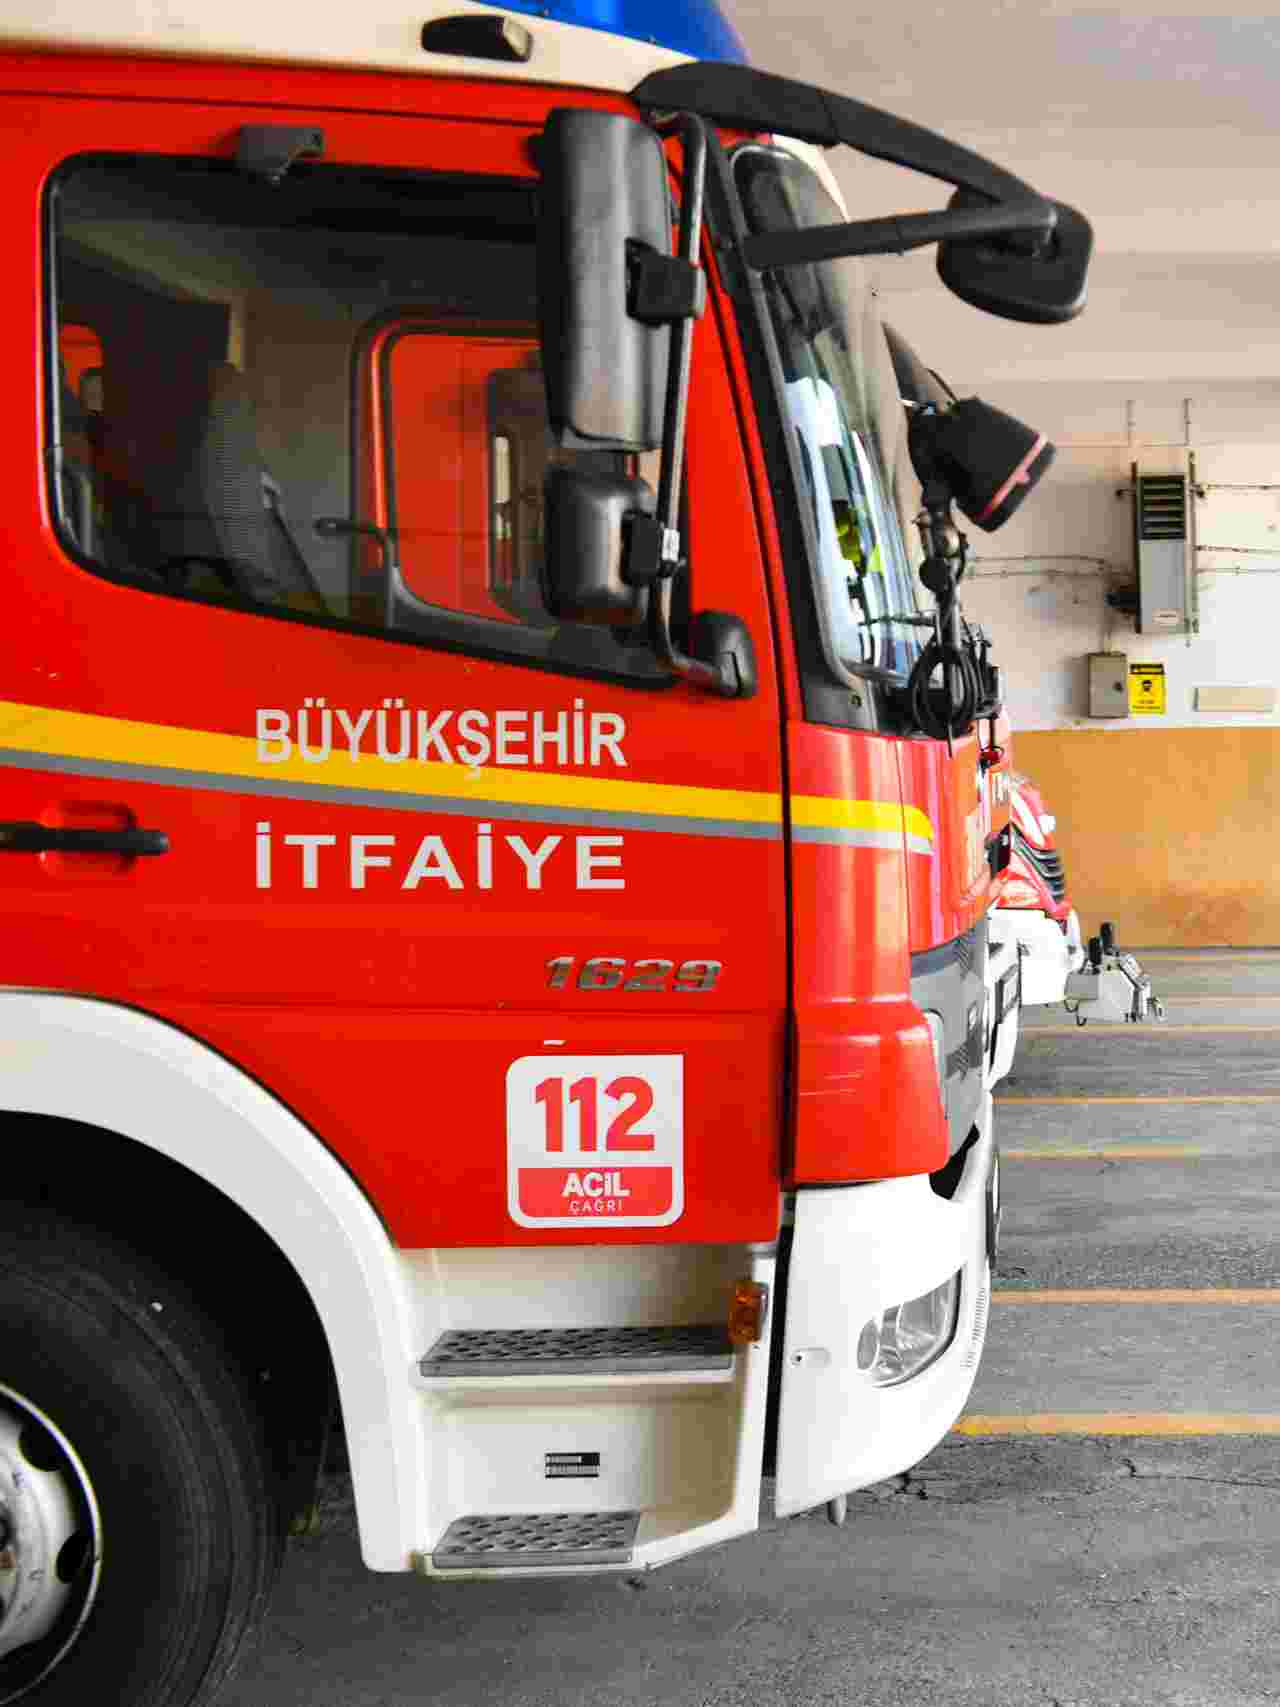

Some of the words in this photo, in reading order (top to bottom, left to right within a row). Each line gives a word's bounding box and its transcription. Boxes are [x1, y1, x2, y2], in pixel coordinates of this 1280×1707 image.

[255, 697, 628, 779] BÜYÜKŞEHİR
[255, 822, 626, 890] İTFAİYE
[545, 956, 722, 992] 1629
[534, 1076, 655, 1152] 112
